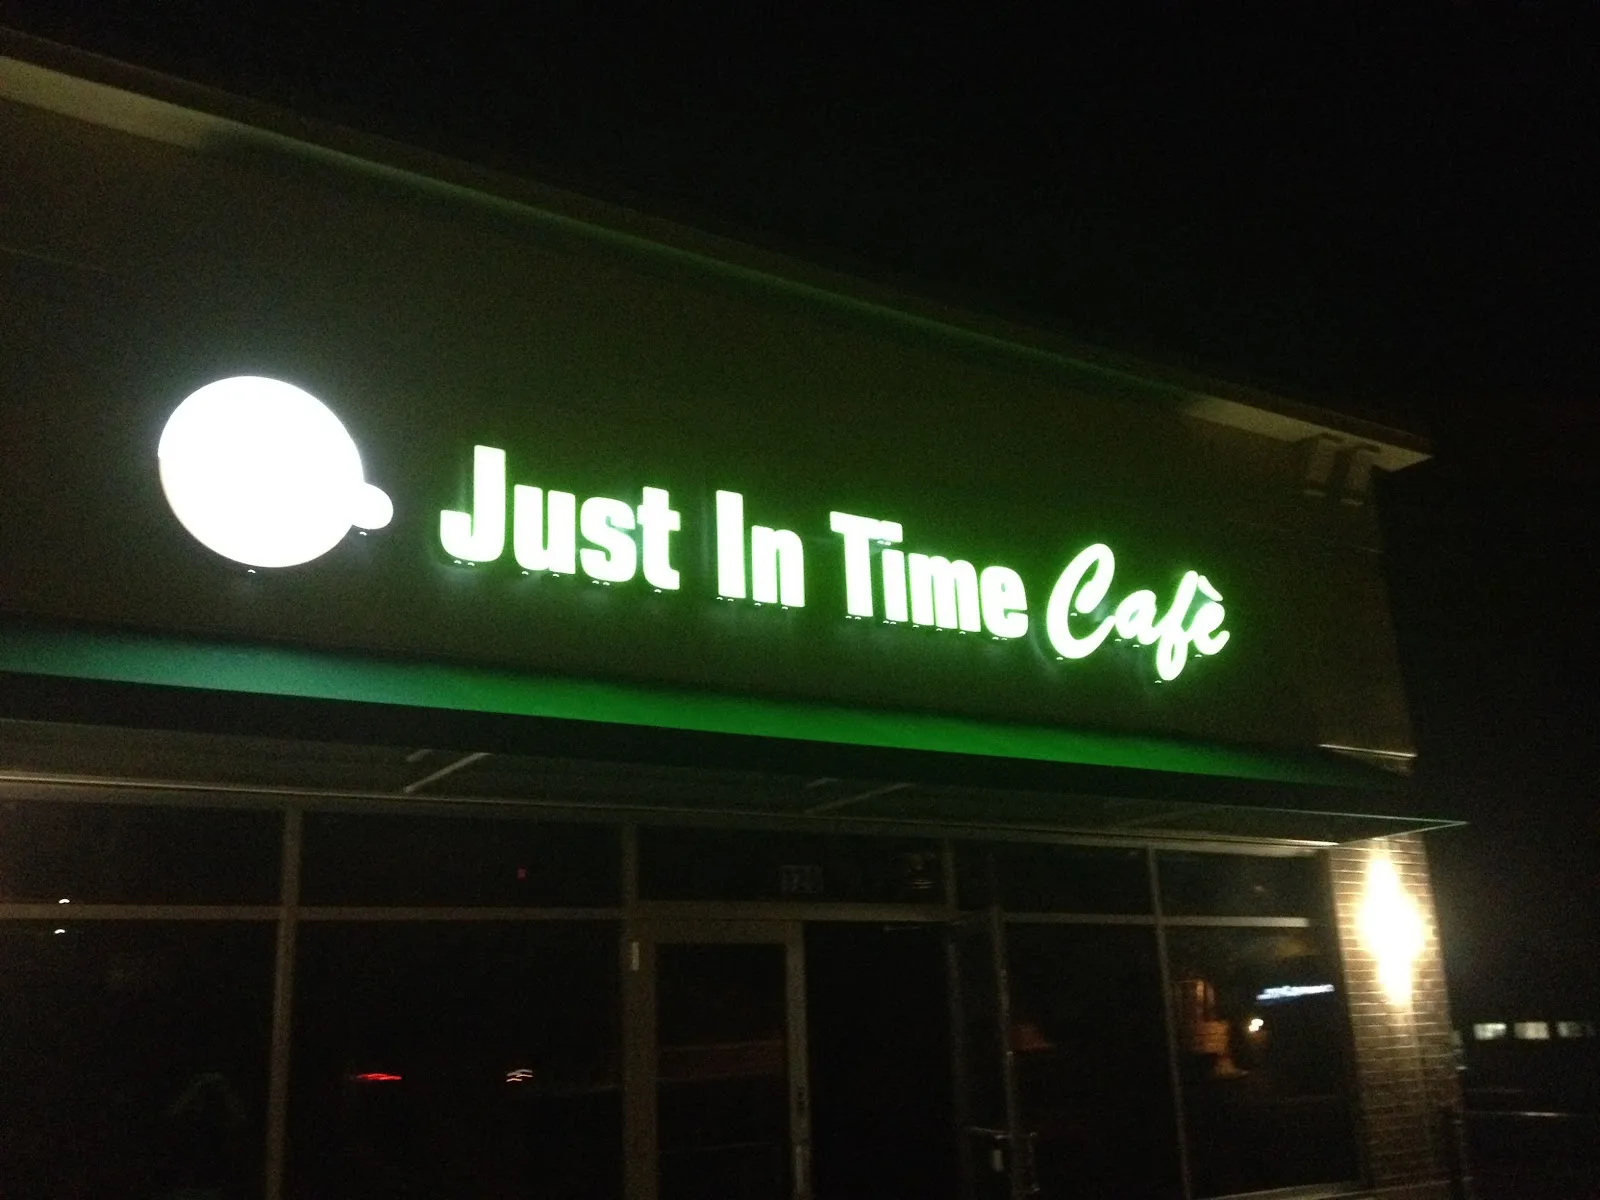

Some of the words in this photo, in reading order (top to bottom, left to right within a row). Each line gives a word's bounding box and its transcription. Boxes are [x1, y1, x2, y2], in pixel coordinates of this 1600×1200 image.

[440, 445, 681, 591] Just
[715, 489, 806, 609] In
[829, 510, 1029, 639] Time
